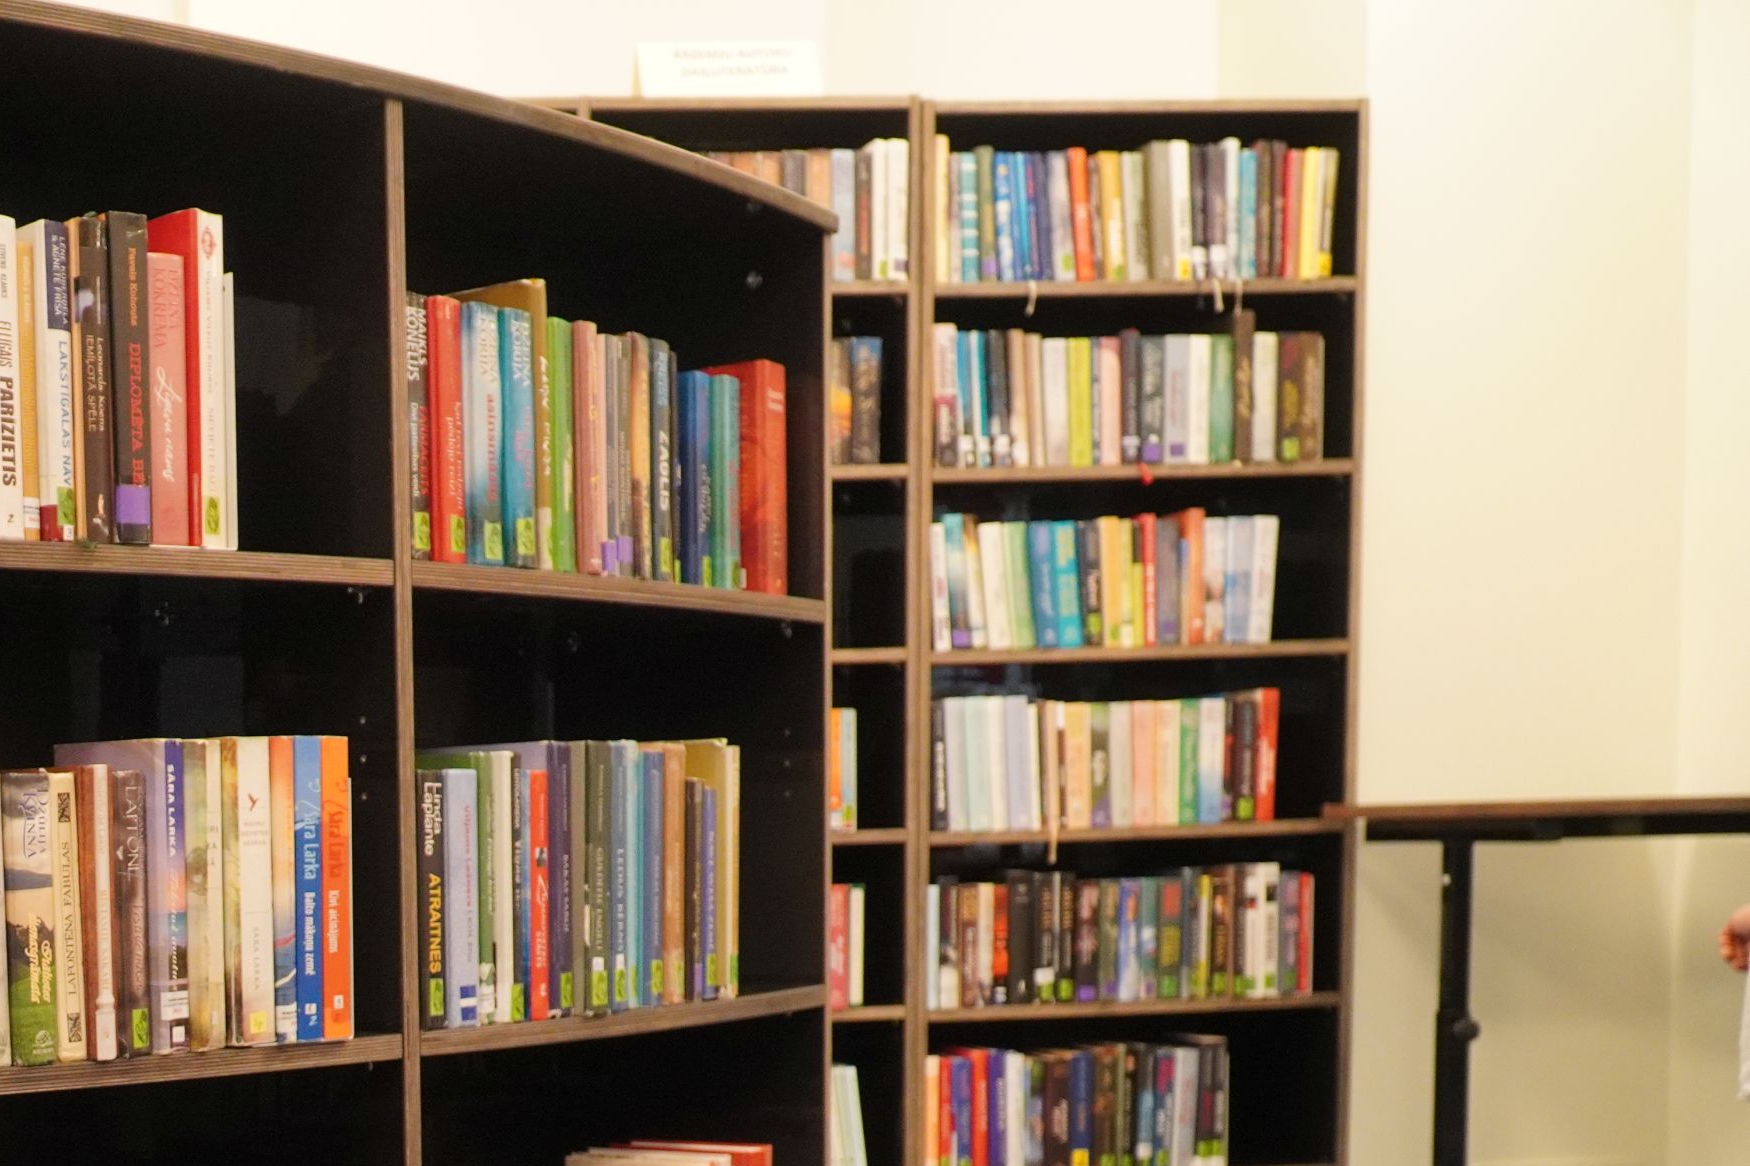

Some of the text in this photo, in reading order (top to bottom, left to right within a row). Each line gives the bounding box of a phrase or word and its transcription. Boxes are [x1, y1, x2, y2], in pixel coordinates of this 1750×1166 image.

[0, 376, 17, 486] PARĪZIETIS
[433, 782, 442, 834] Linda
[58, 841, 72, 906] FABULAS
[303, 843, 319, 879] Larka
[429, 873, 441, 973] ATRAITNES
